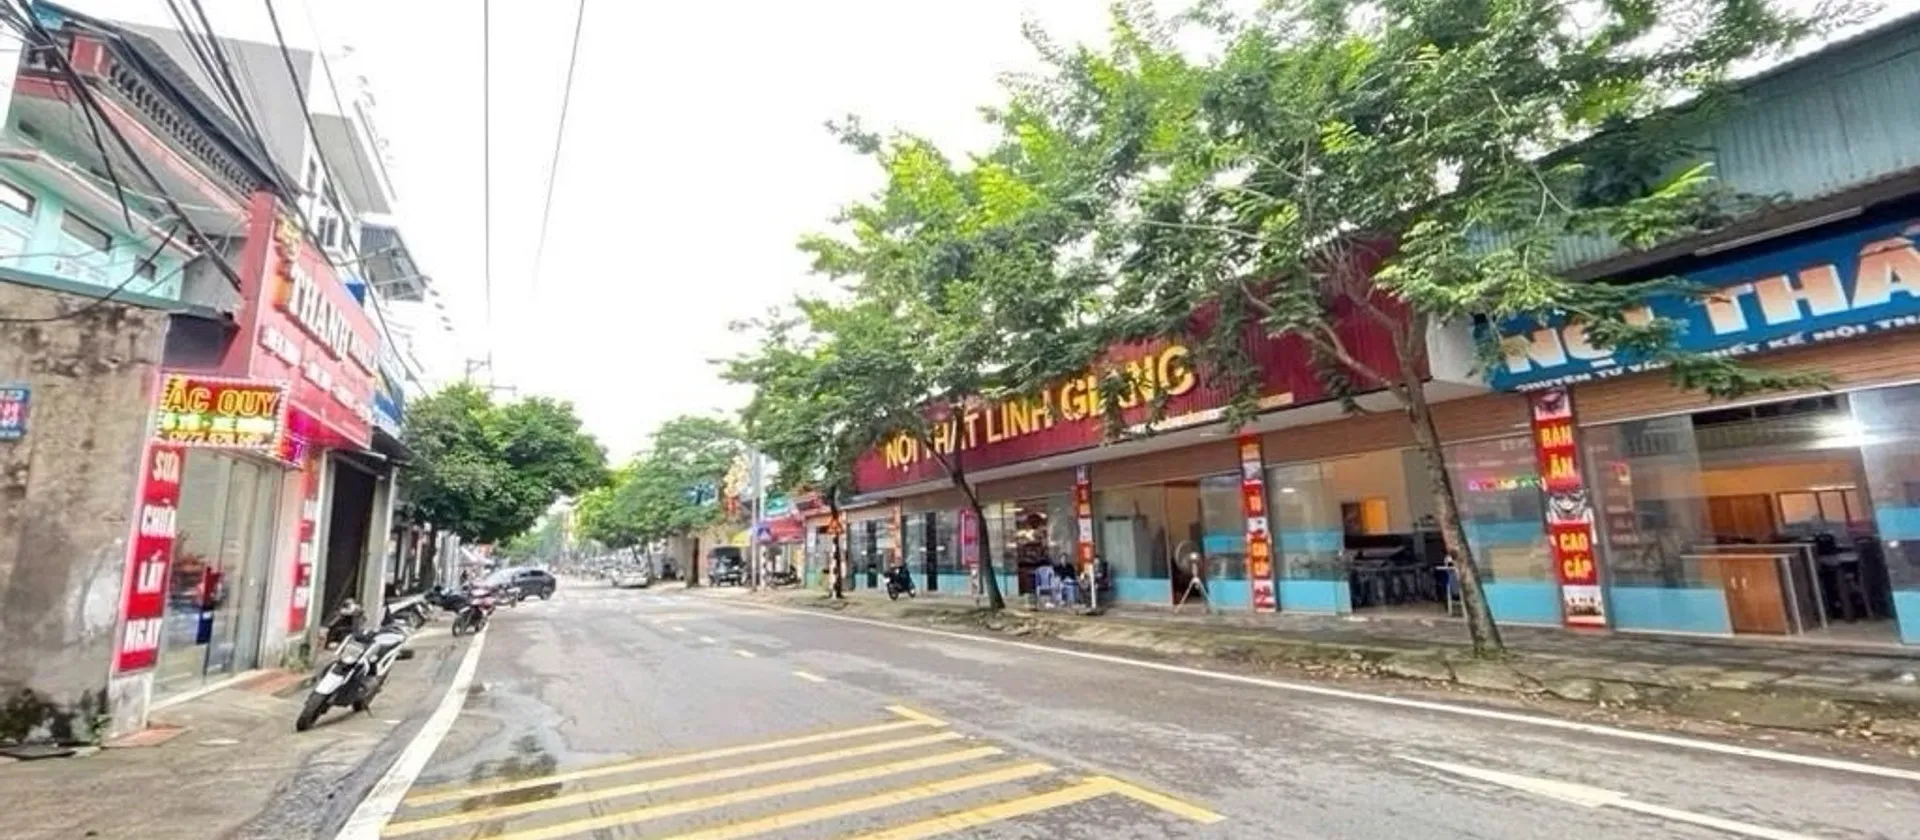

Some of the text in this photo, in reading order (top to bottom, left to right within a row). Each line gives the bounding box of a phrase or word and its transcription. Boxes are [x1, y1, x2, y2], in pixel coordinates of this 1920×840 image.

[1873, 311, 1920, 331] TH
[217, 389, 280, 417] QUY
[886, 430, 918, 473] NỘI
[984, 388, 1053, 444] LINH
[1559, 531, 1589, 552] CAO
[1563, 555, 1593, 579] CẤP
[123, 617, 164, 654] NGAY
